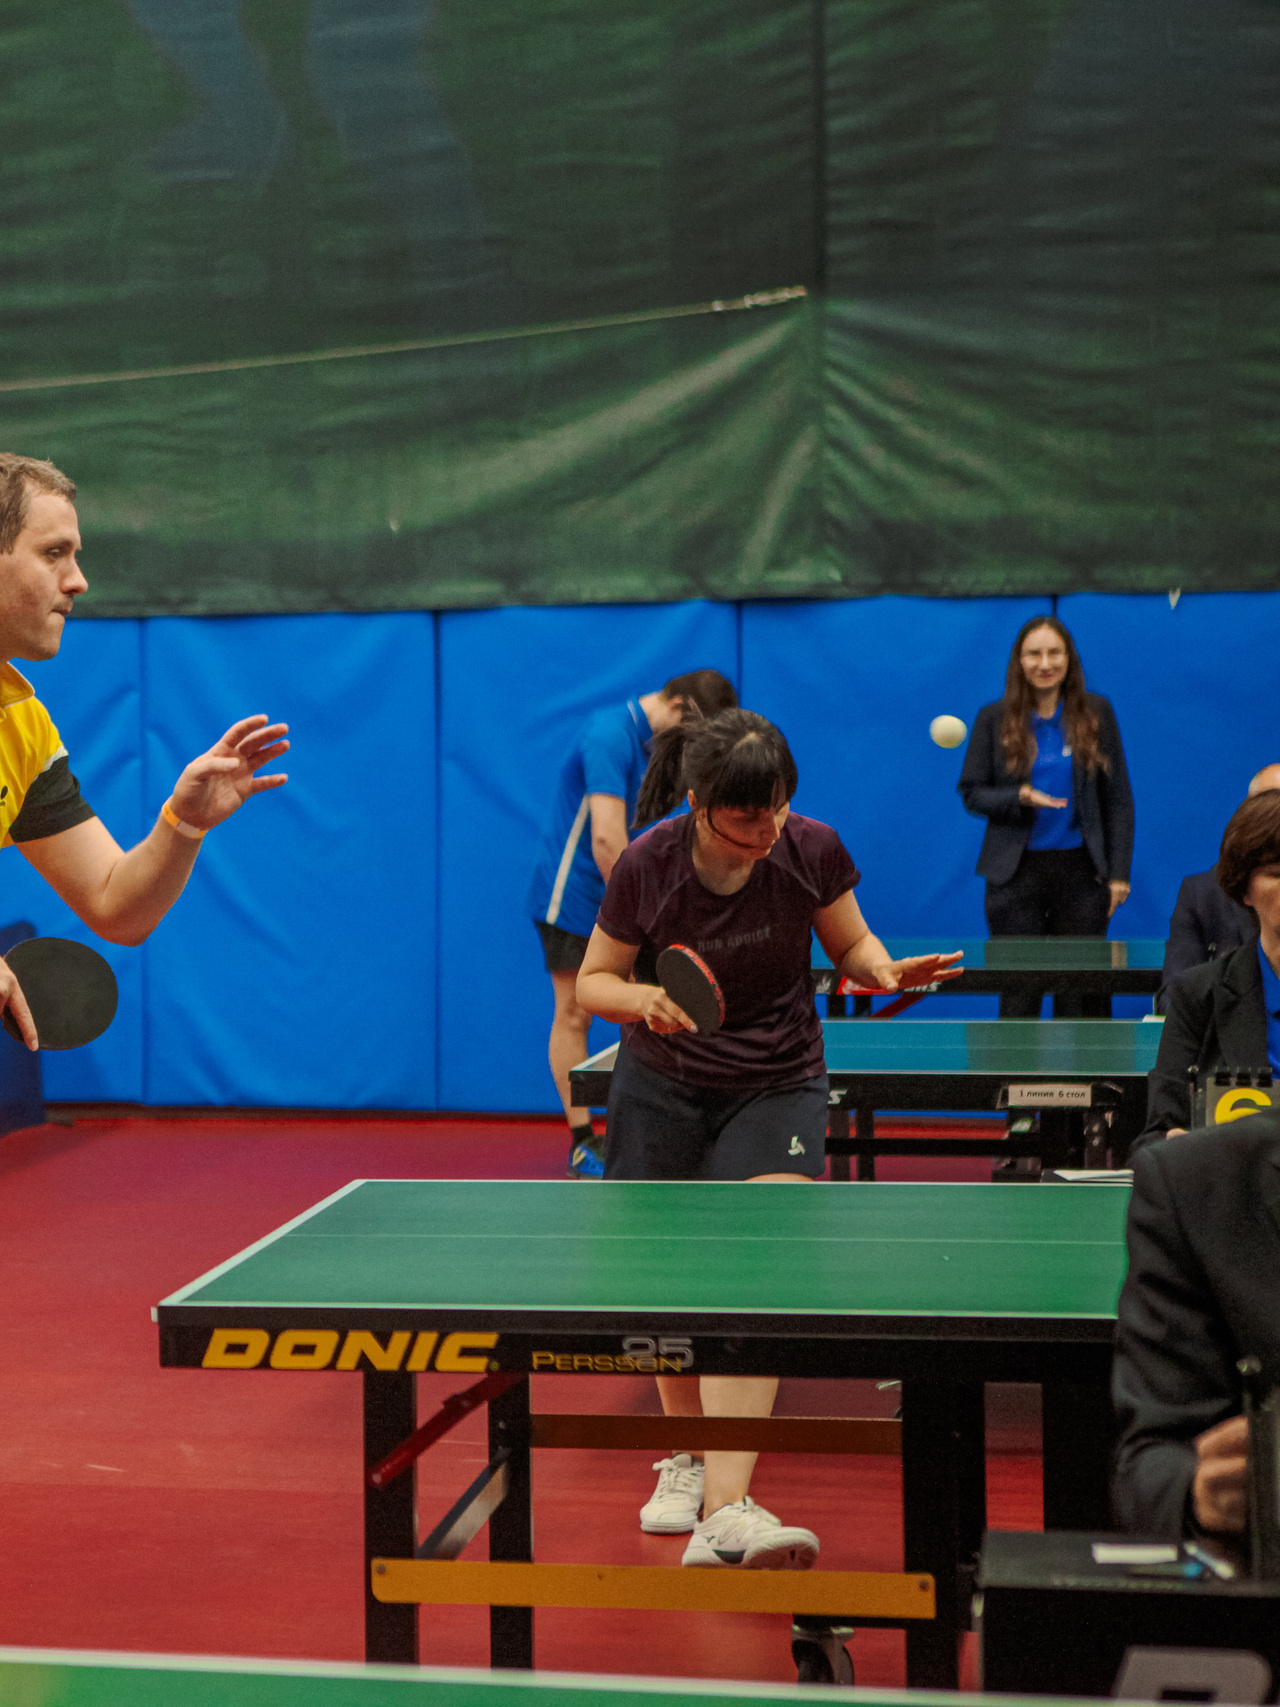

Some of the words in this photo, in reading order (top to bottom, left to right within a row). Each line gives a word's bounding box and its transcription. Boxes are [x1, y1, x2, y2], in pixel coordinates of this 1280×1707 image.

[1026, 1090, 1054, 1098] линия
[1066, 1091, 1086, 1099] стол
[201, 1328, 499, 1372] DONIC
[622, 1336, 694, 1368] 25
